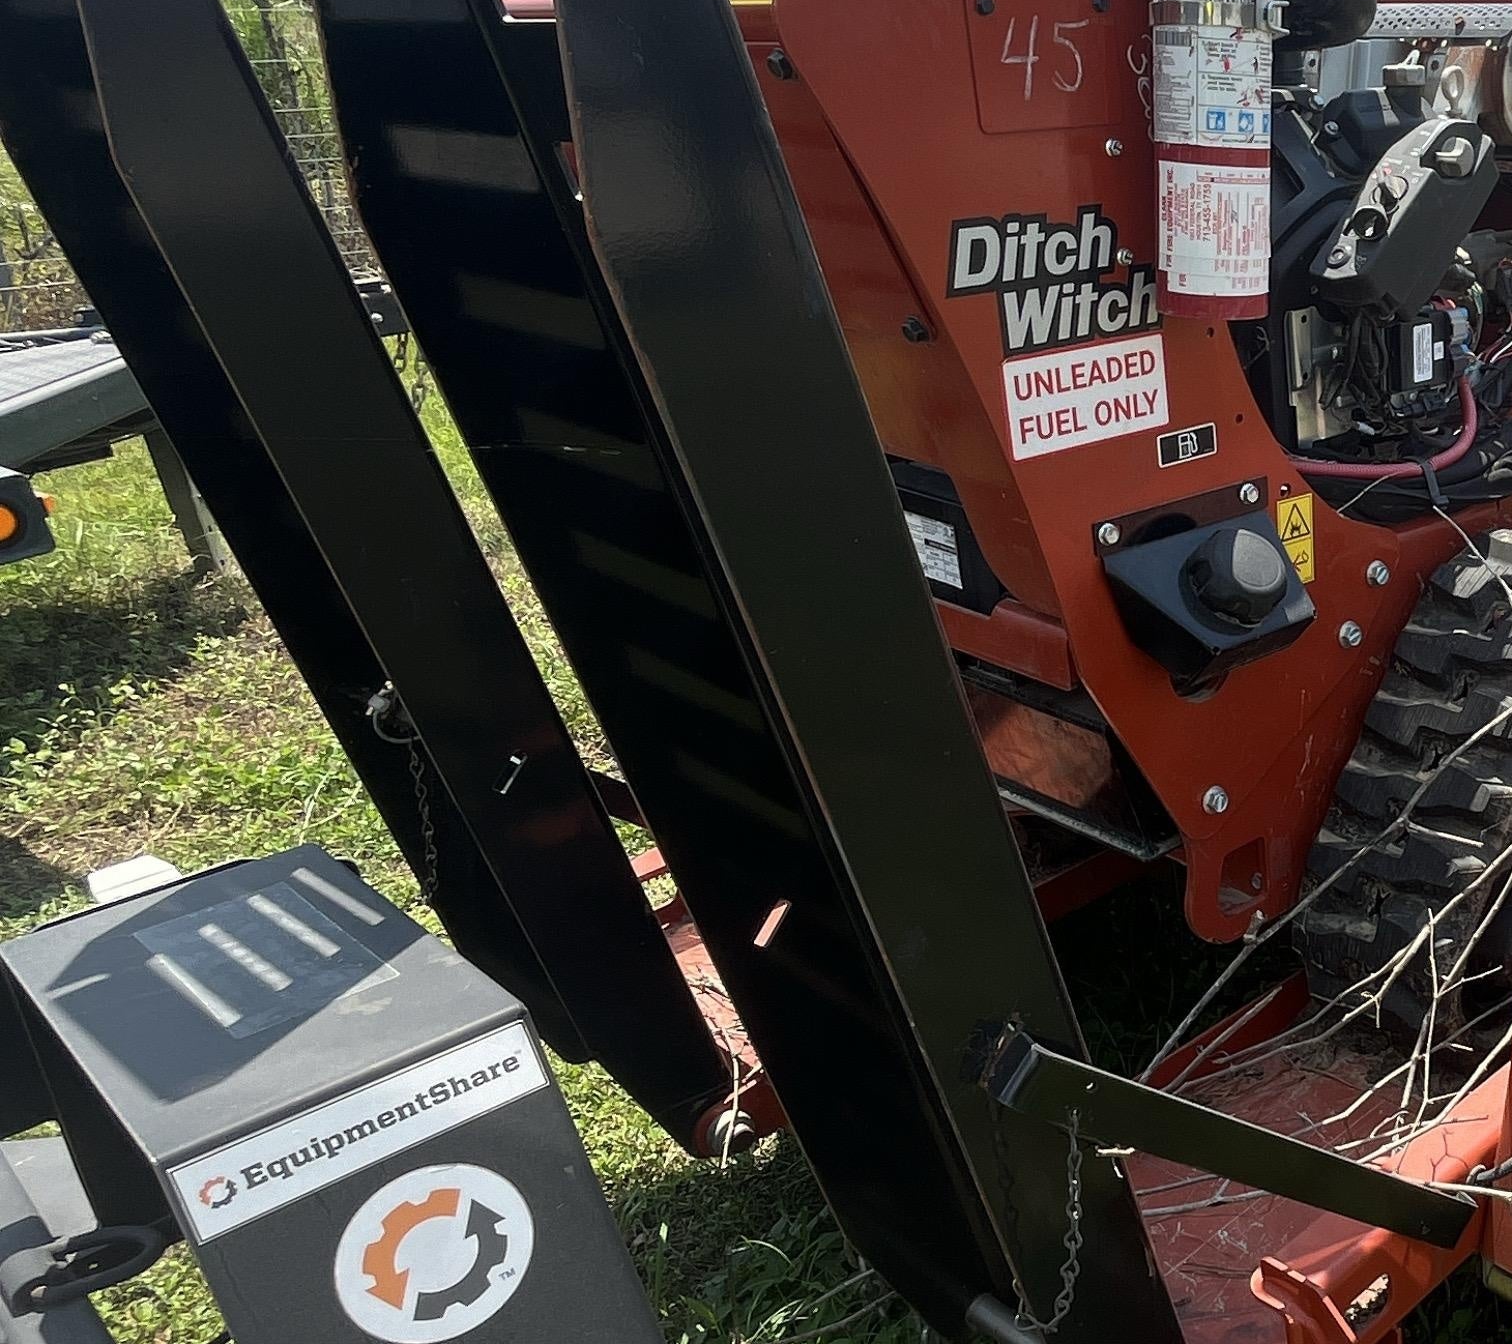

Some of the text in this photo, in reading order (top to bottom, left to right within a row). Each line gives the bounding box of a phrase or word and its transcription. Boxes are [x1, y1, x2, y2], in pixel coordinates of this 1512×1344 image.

[1001, 14, 1089, 100] 45
[953, 213, 1112, 289] Ditch
[1003, 271, 1159, 349] Witch
[1014, 350, 1156, 401] UNLEADED
[1019, 389, 1159, 445] FUEL ONLY
[240, 1054, 521, 1190] EquipmentShare
